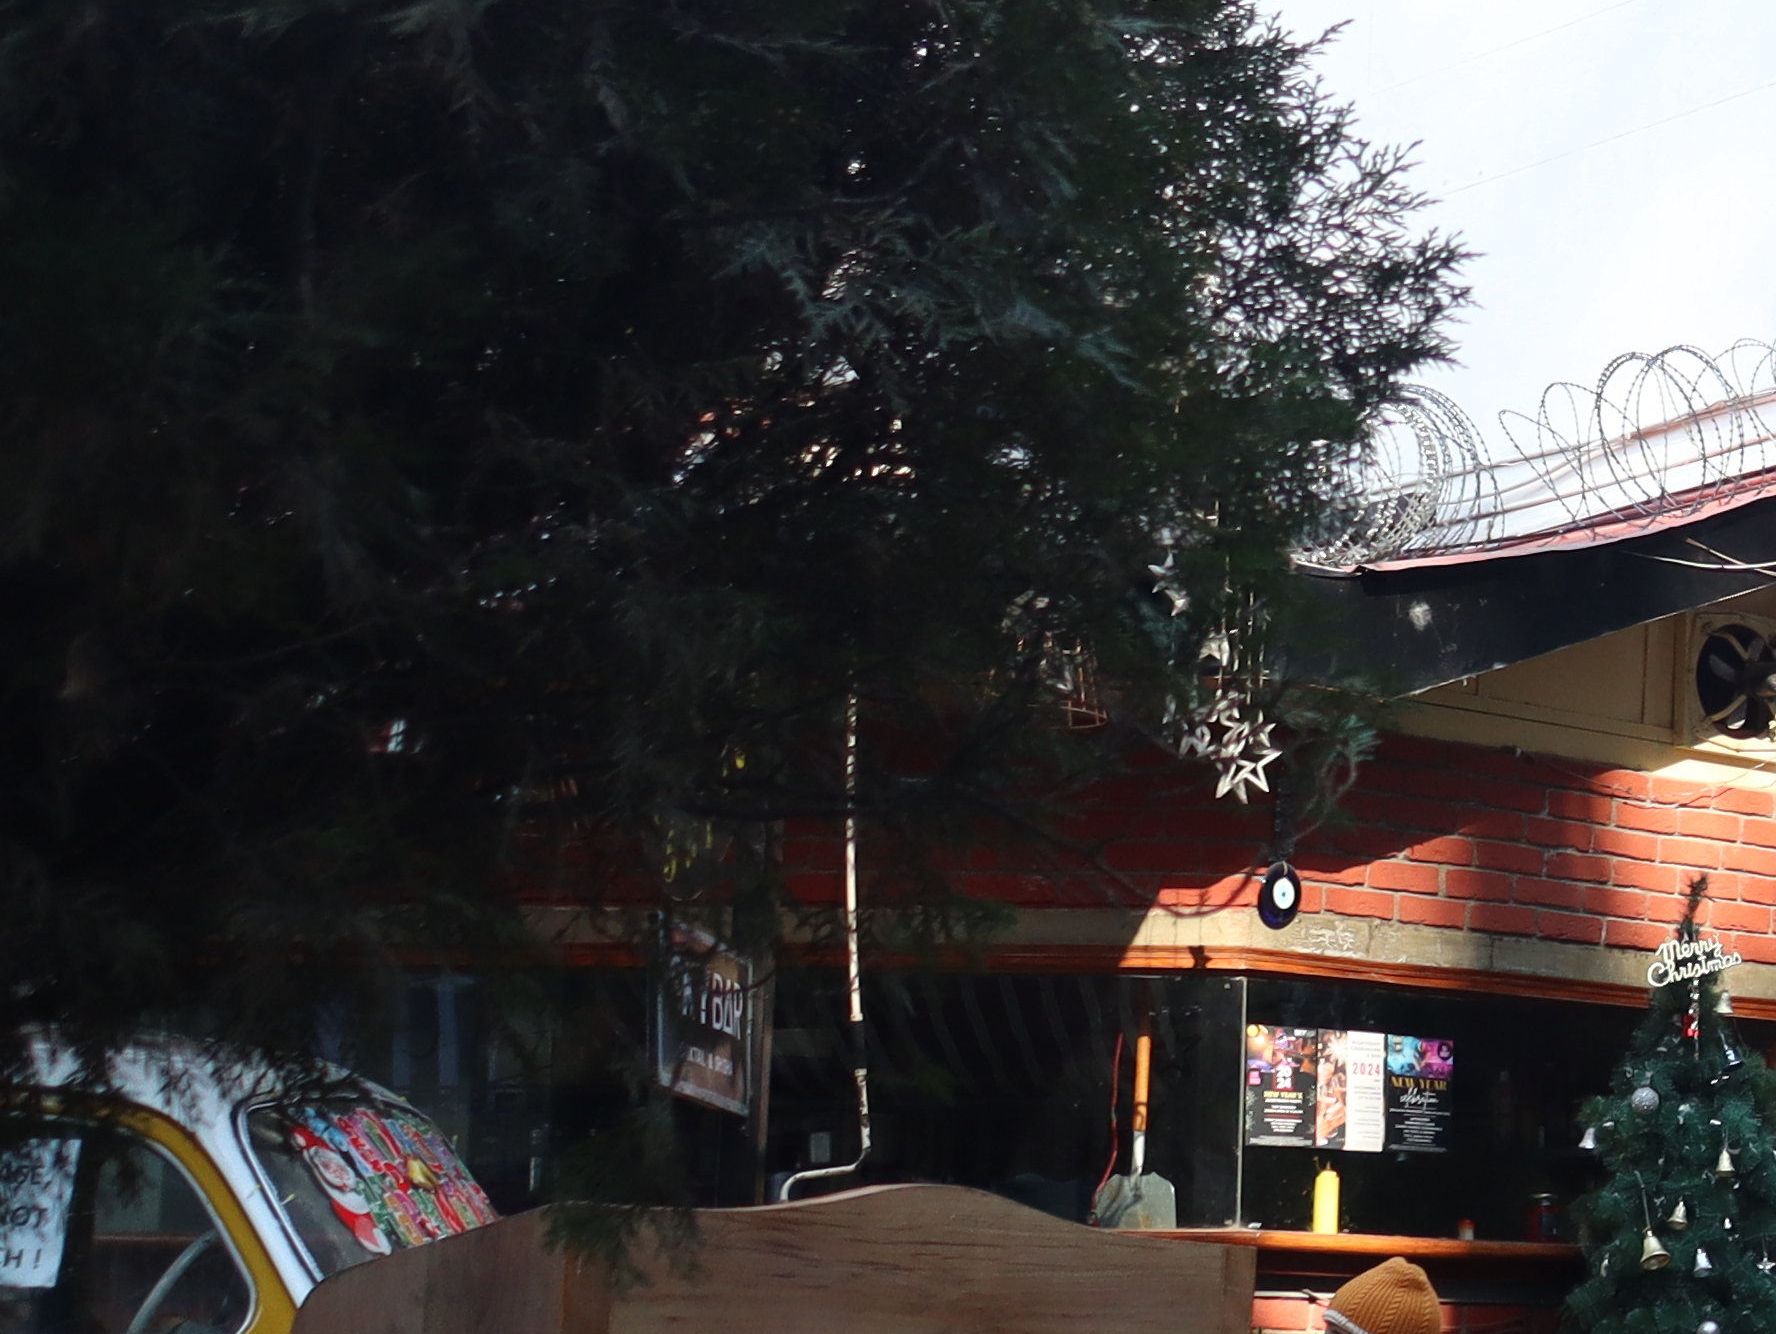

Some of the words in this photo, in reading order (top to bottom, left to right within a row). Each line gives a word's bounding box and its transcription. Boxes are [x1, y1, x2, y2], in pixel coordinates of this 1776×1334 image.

[1655, 937, 1724, 964] Merry
[1647, 951, 1742, 987] Christmas
[1352, 1062, 1381, 1076] 2024
[1391, 1076, 1415, 1088] NEW
